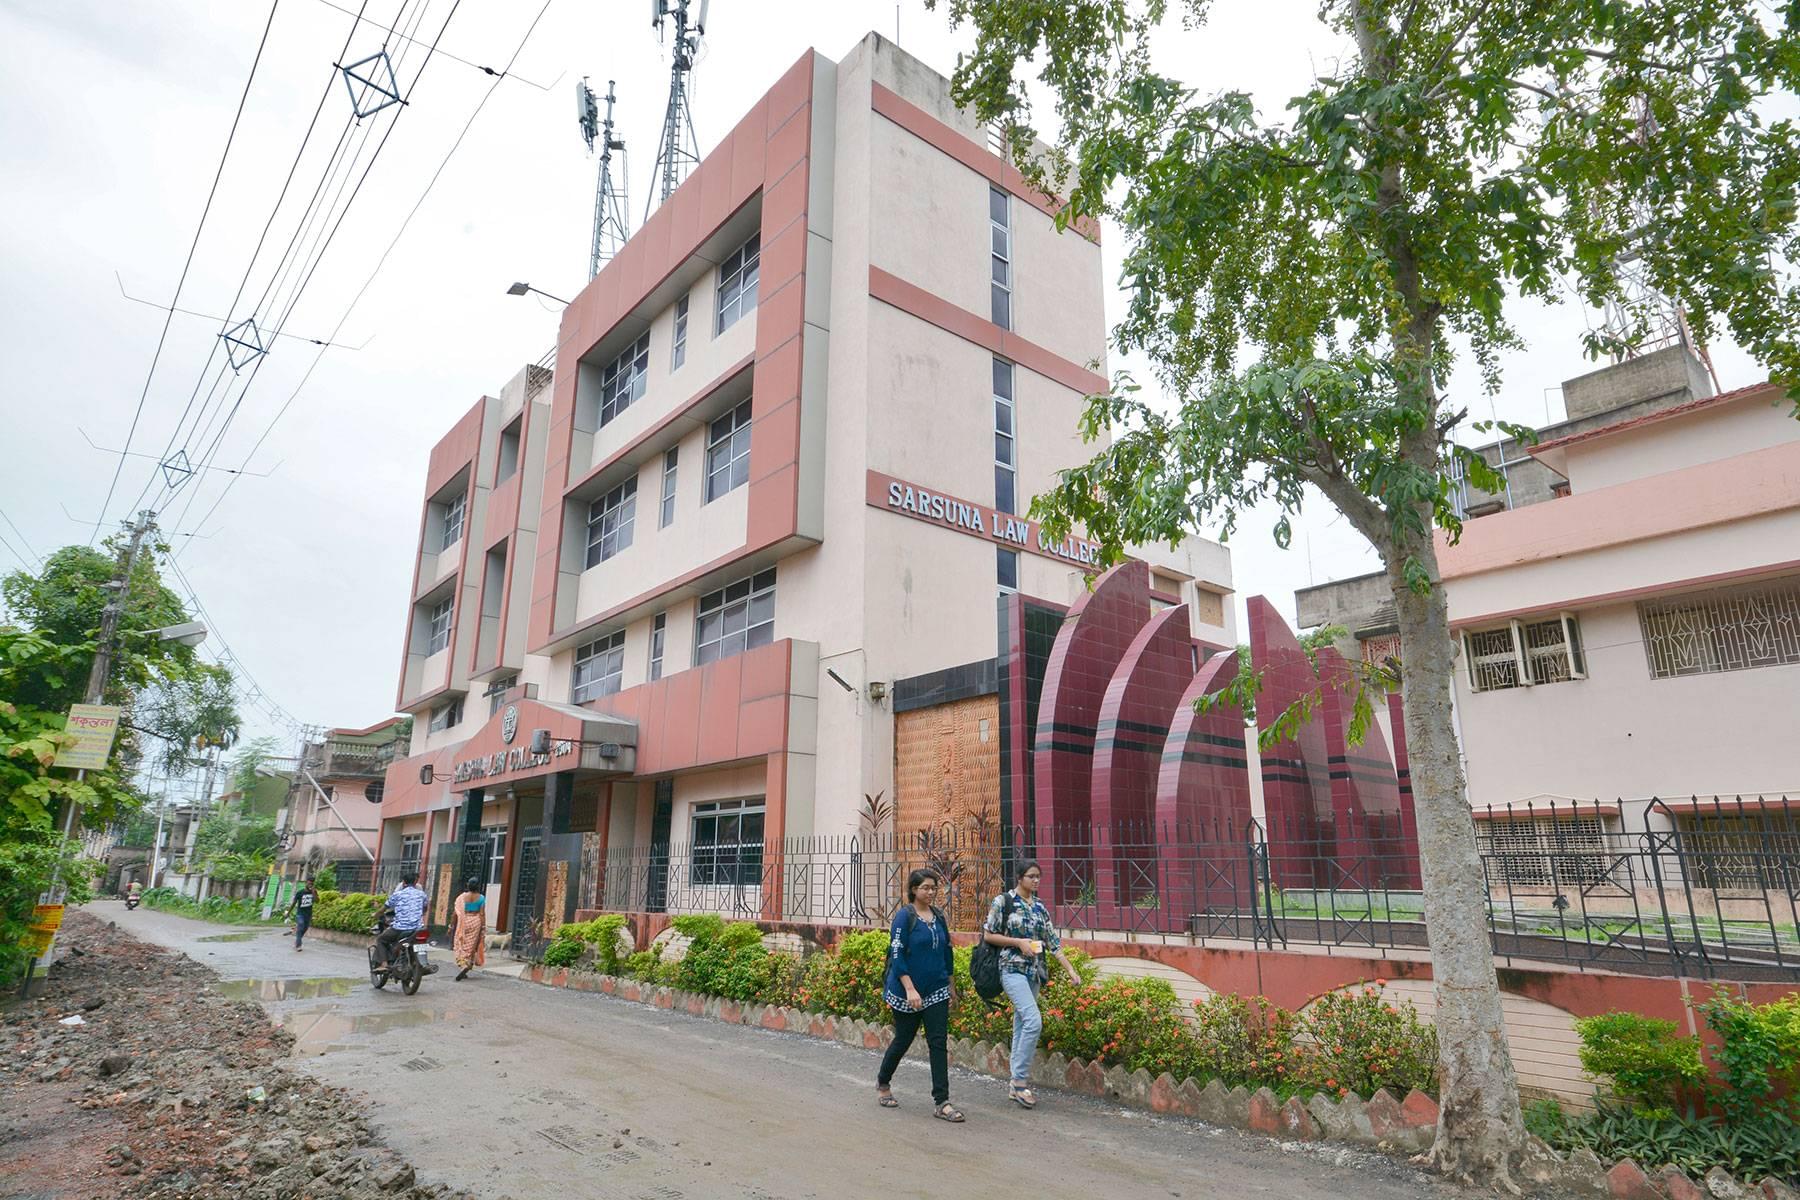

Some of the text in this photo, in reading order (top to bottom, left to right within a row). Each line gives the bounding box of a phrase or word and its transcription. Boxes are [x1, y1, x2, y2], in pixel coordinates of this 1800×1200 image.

[888, 481, 1101, 564] SARSUNA LAW COLLEG
